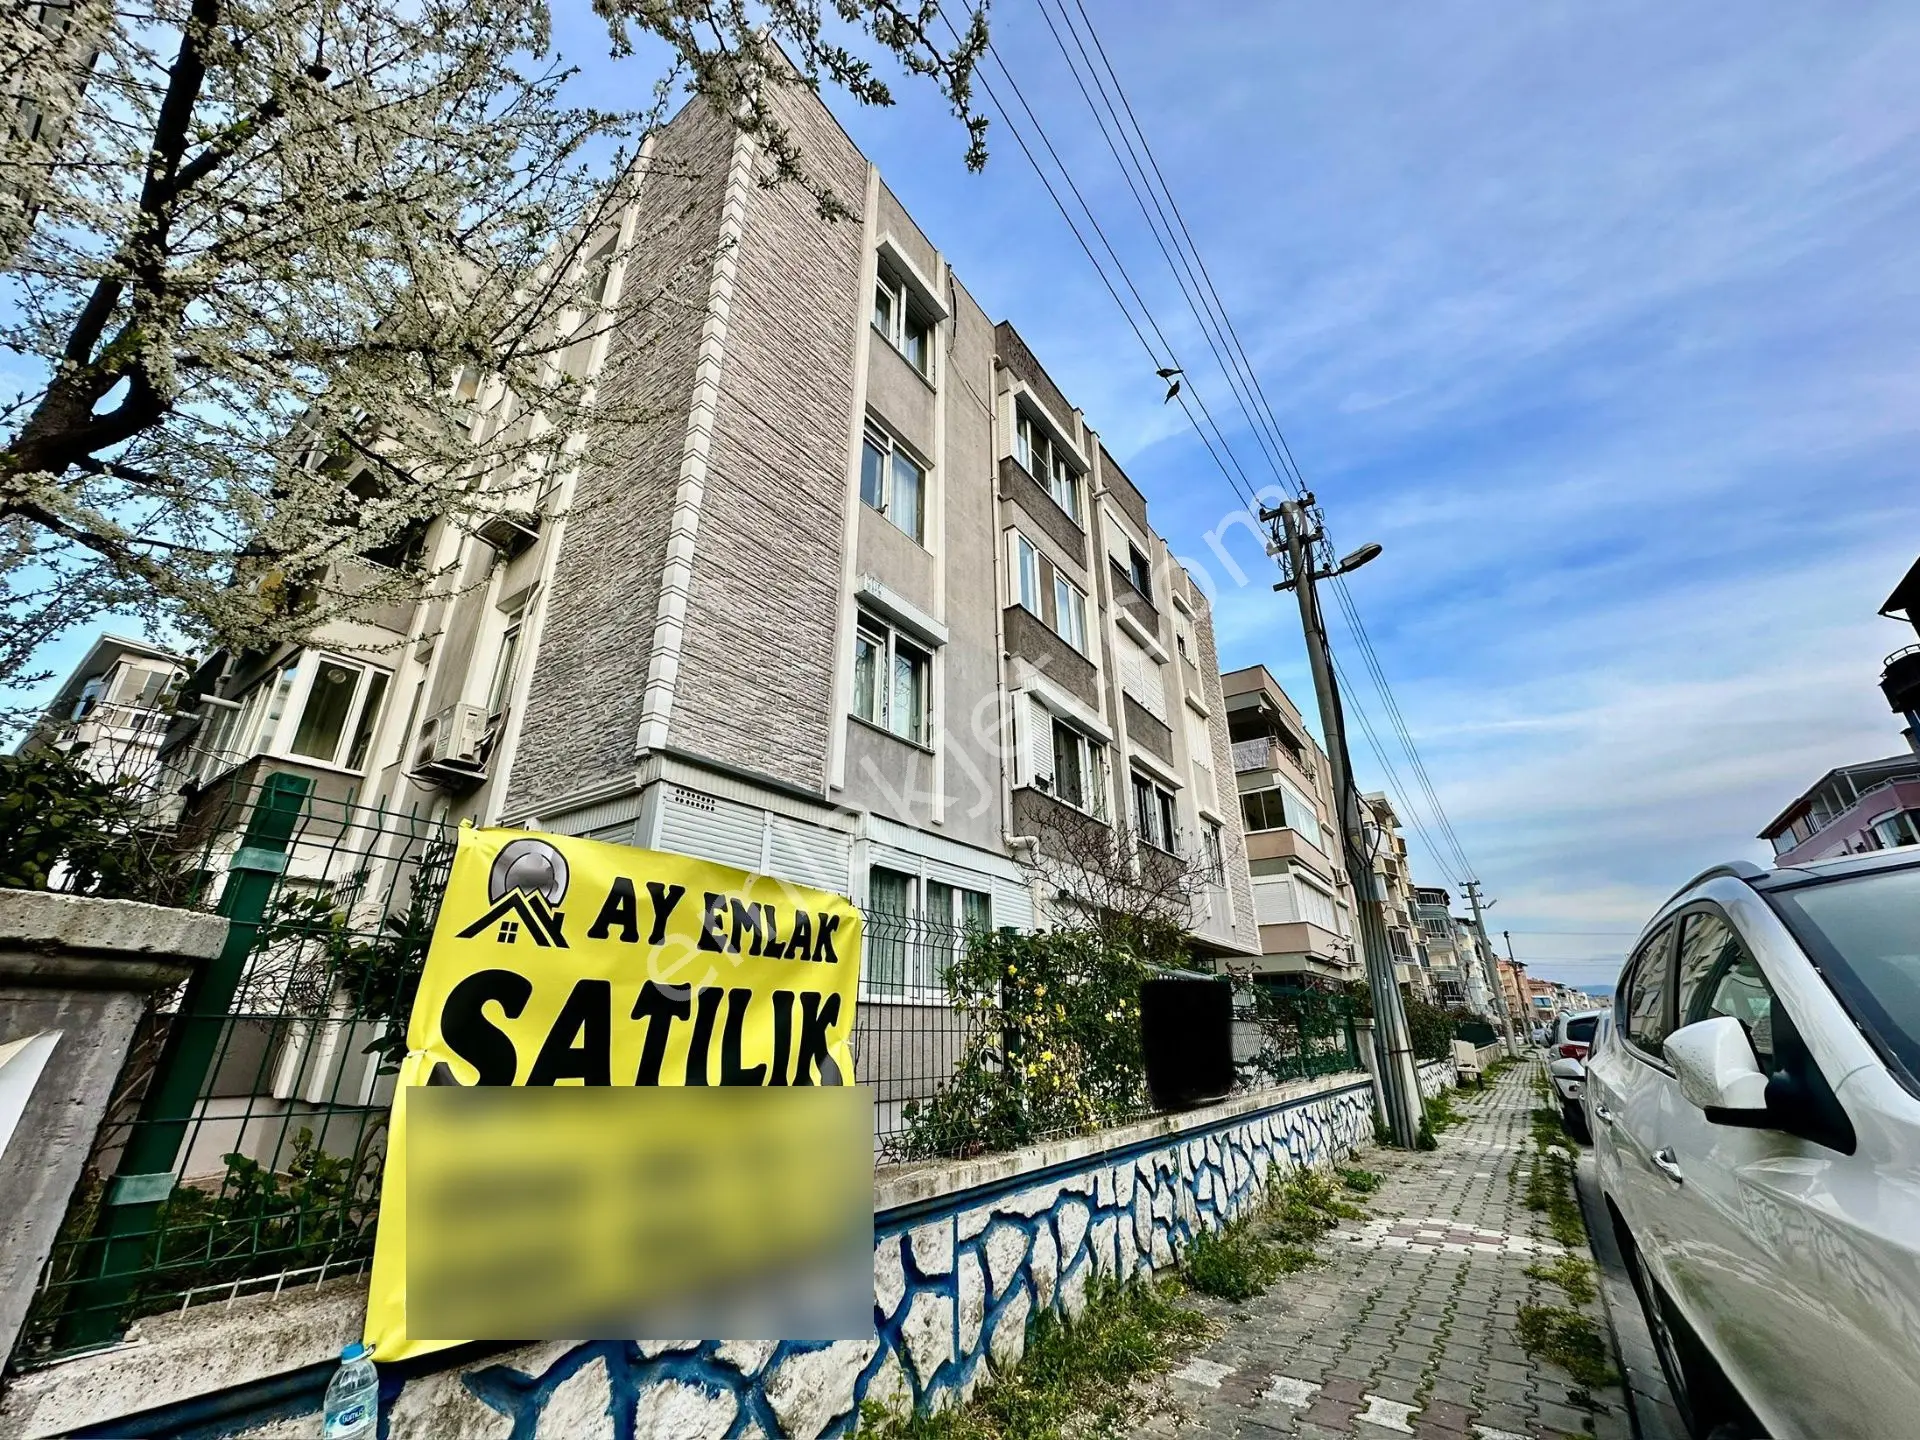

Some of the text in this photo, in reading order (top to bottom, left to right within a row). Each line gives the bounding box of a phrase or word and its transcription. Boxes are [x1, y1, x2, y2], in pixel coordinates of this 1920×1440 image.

[588, 876, 840, 964] AY EMLAK
[427, 968, 843, 1086] SATILIK
